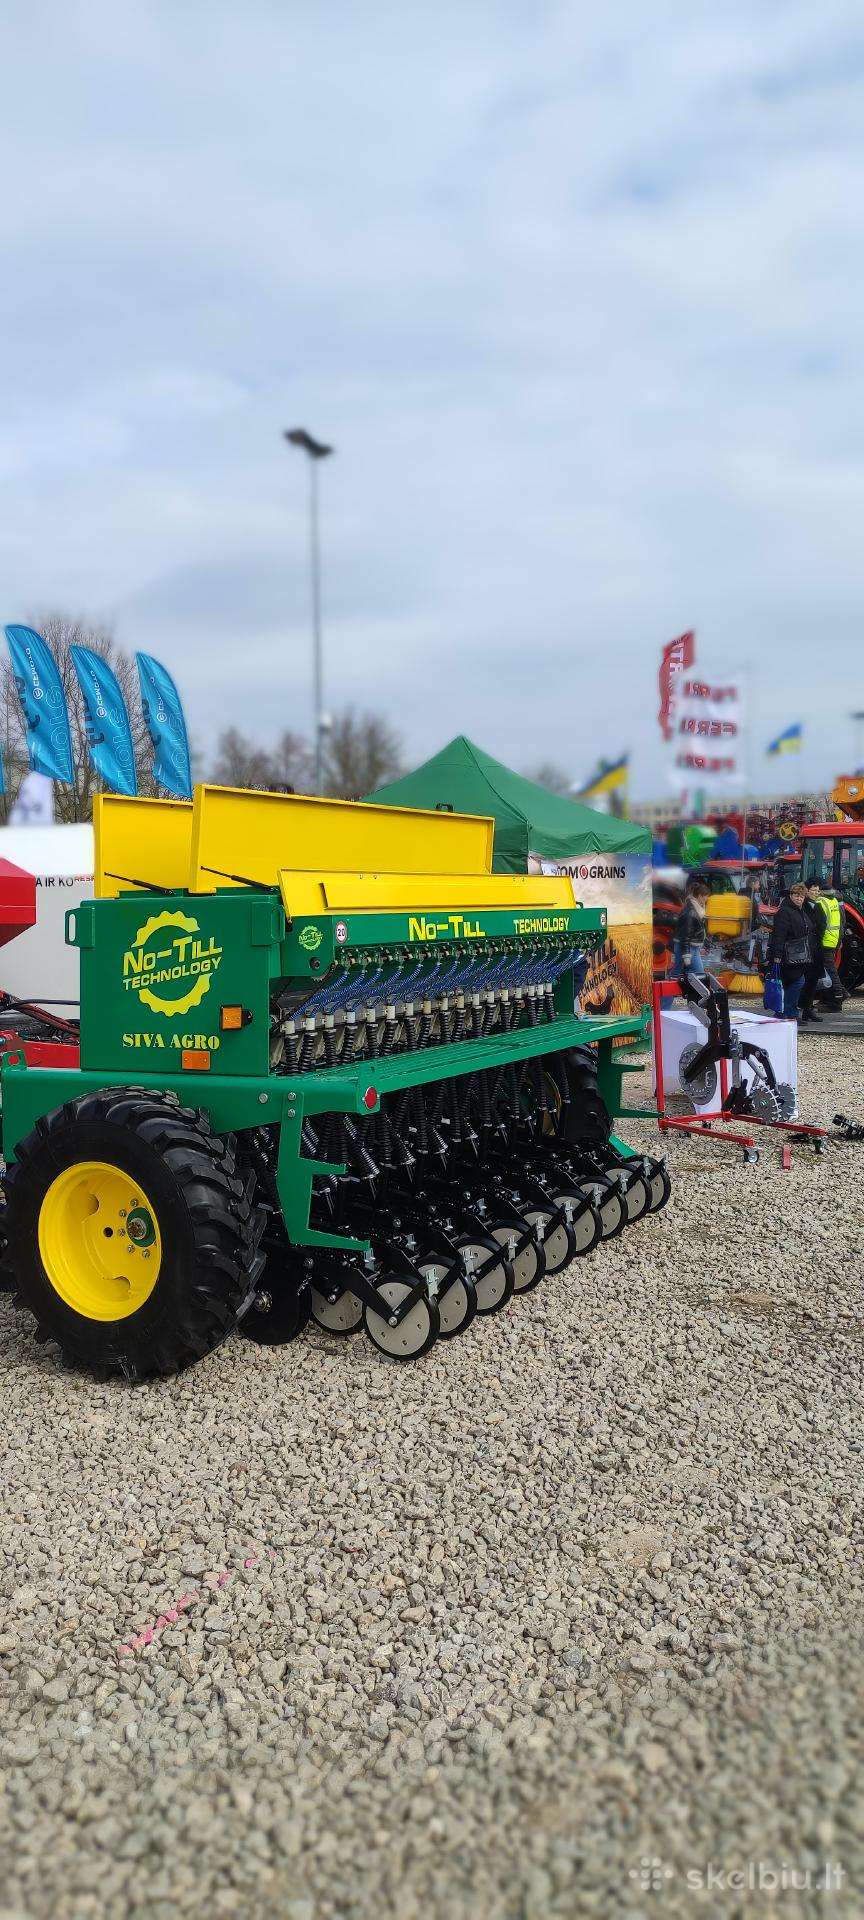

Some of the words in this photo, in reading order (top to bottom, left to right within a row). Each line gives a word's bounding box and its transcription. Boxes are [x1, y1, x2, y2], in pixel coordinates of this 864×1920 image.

[58, 877, 74, 887] KO
[337, 928, 345, 937] 20
[513, 917, 570, 935] TECHNOLOGY
[122, 956, 223, 991] TECHNOLOGY
[123, 1033, 165, 1049] SIVA
[169, 1033, 220, 1050] AGRO
